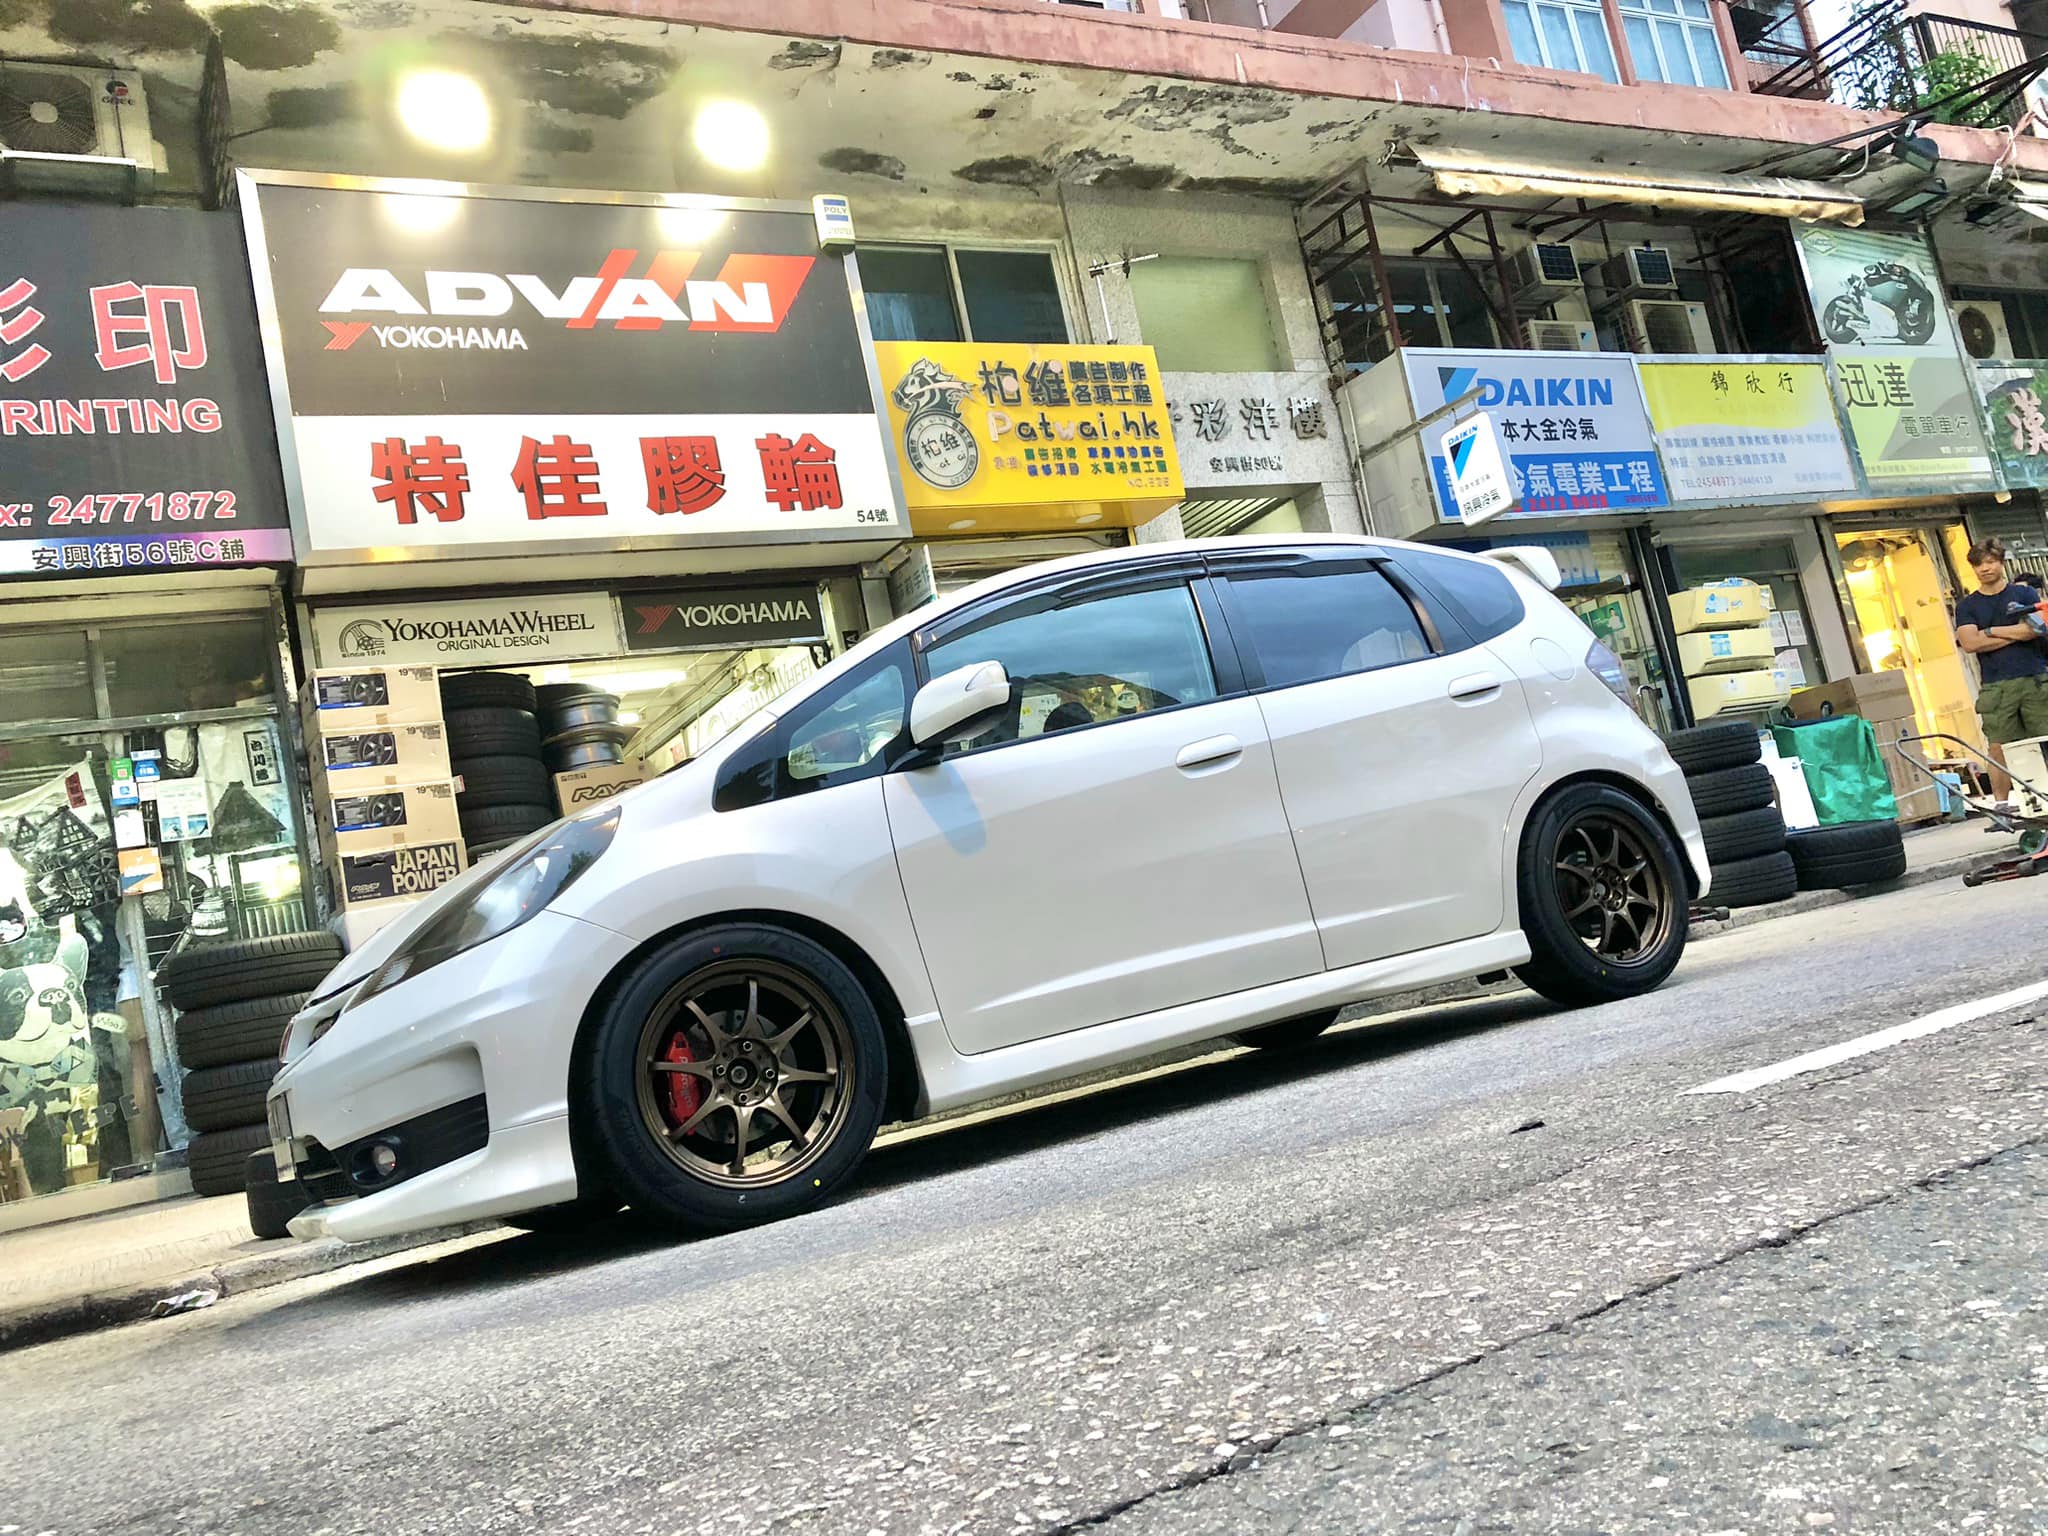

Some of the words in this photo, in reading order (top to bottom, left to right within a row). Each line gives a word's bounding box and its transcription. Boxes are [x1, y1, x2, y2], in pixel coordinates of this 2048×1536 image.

[318, 268, 775, 324] ADVAN
[371, 325, 529, 350] YOKOHAMA
[1072, 384, 1153, 406] 各項工程
[1477, 378, 1613, 407] DAIKIN
[1710, 370, 1795, 396] 錦欣行
[1837, 361, 1915, 408] 迅達
[0, 398, 223, 435] RINTING
[987, 411, 1161, 442] Patwai.hk
[1166, 395, 1328, 442] 彩洋樓
[1901, 416, 1970, 438] 電單車行
[1448, 425, 1478, 446] DAIKIN
[370, 433, 845, 525] 特佳膠輪
[48, 490, 237, 525] 24771872
[856, 508, 889, 523] 54號
[32, 538, 246, 570] 安興街56號C舖
[382, 615, 514, 642] YOKOHAMA
[510, 608, 595, 633] WHEEL
[677, 600, 812, 628] YOKOHAMA
[366, 649, 387, 657] 1974
[437, 638, 501, 651] ORIGINAL
[504, 634, 550, 647] DESIGN
[390, 845, 457, 874] JAPAN
